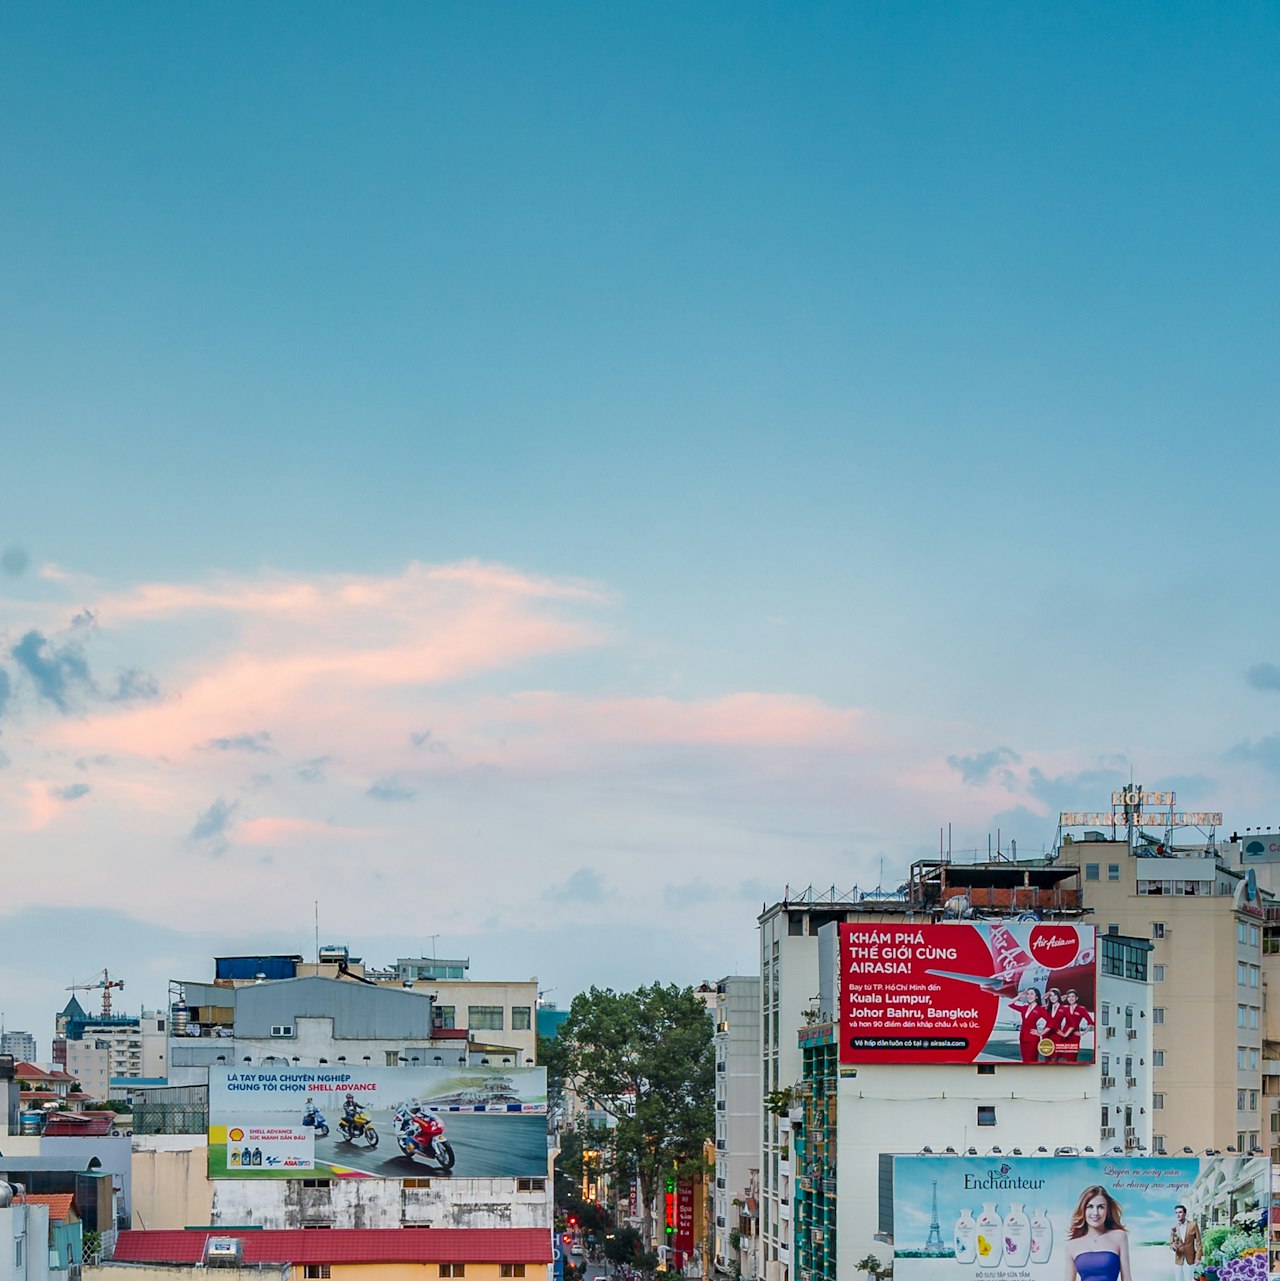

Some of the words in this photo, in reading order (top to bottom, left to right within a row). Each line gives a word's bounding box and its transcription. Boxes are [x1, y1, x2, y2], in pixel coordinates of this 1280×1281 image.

[1112, 792, 1176, 805] HOTEL
[1061, 813, 1127, 826] HOANG
[1171, 813, 1222, 826] LONG
[849, 930, 891, 944] KHÁM
[895, 930, 925, 944] PHÁ
[849, 944, 879, 959] THẾ
[882, 945, 912, 959] GIỚI
[916, 945, 957, 959] CÙNG
[849, 962, 911, 973] AIRASIA!
[850, 993, 882, 1003] Kuala
[885, 993, 933, 1005] Lumpur,
[849, 1008, 884, 1018] Johor
[887, 1008, 924, 1019] Bahru,
[927, 1008, 979, 1020] Bangkok
[279, 1073, 316, 1082] CHUYÊN
[317, 1073, 351, 1082] NGHIỆP
[227, 1083, 260, 1091] CHÚNG
[263, 1083, 277, 1091] TÔI
[280, 1083, 306, 1092] CHỌN
[336, 1083, 377, 1091] ADVANCE
[964, 1169, 1045, 1190] Enchanteur
[679, 1205, 692, 1214] Spa
